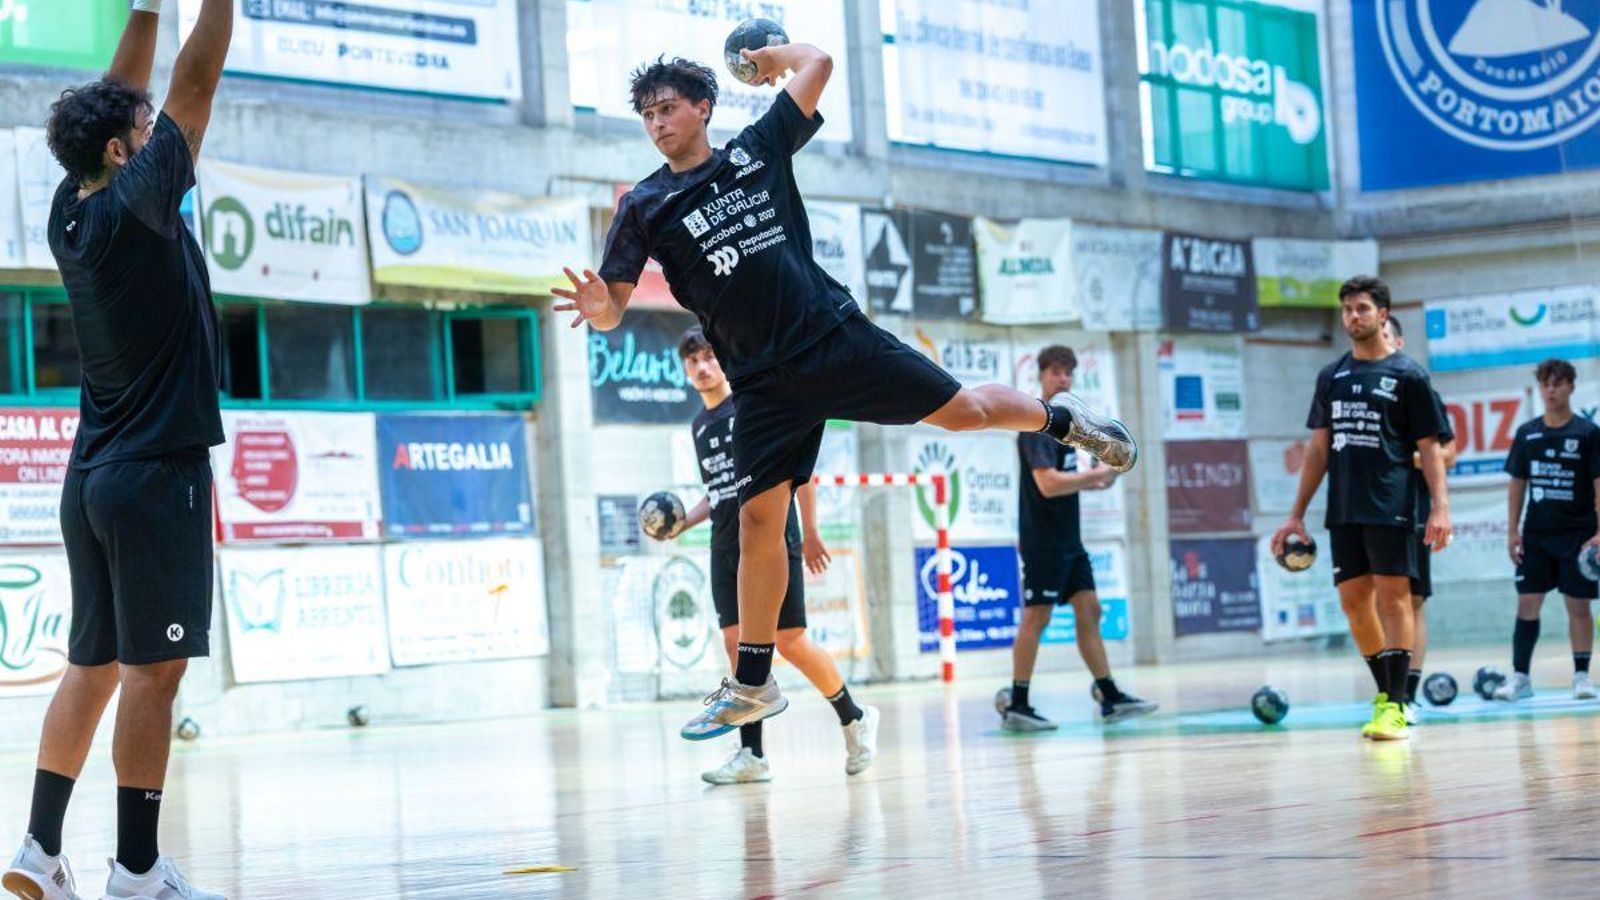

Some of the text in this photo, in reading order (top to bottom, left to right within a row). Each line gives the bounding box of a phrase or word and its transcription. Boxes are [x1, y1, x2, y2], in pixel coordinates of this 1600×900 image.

[1150, 38, 1271, 95] nodosa
[1418, 70, 1600, 134] PORTOMAIO
[703, 188, 745, 216] XUNTA
[709, 190, 770, 226] DE GALICIA
[429, 208, 471, 236] SAN
[700, 223, 743, 252] Xacobeo
[393, 442, 513, 470] ARTEGALIA
